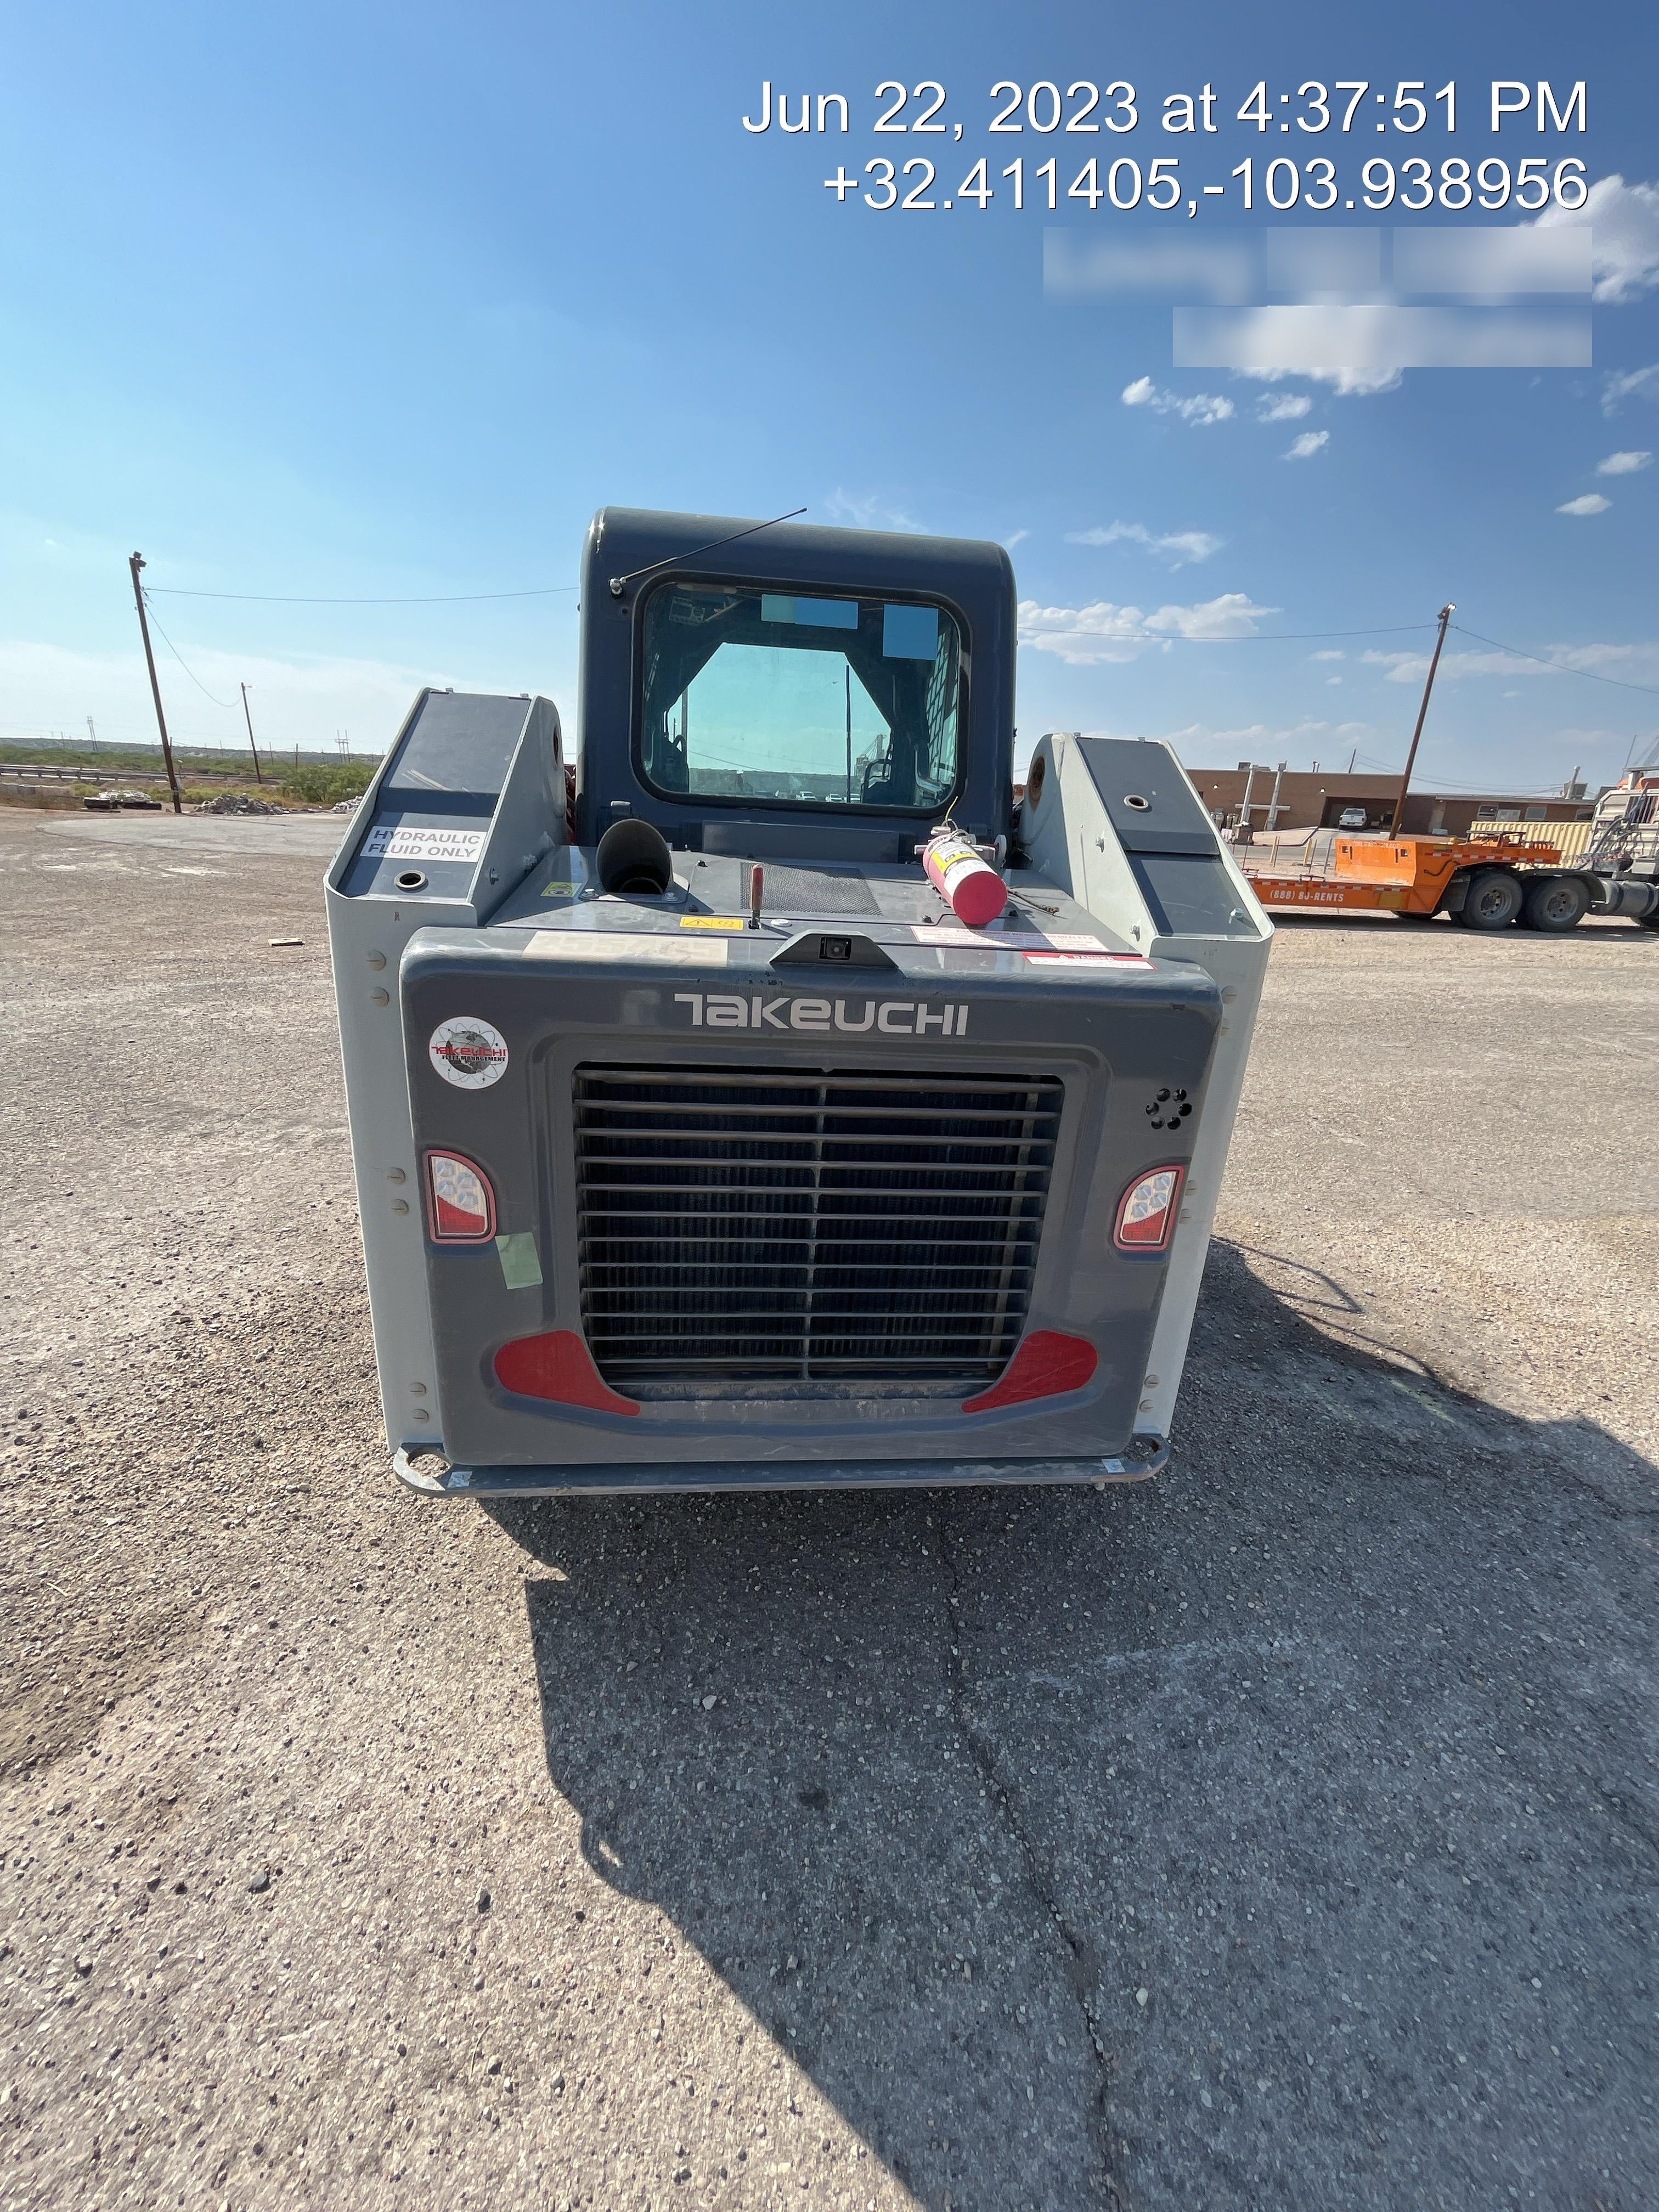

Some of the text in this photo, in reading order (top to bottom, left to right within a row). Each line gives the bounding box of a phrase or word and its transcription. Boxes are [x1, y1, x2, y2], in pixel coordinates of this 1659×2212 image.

[374, 830, 481, 844] HYDRAULIC
[368, 843, 476, 857] FLUID ONLY
[1270, 890, 1295, 900] (888)
